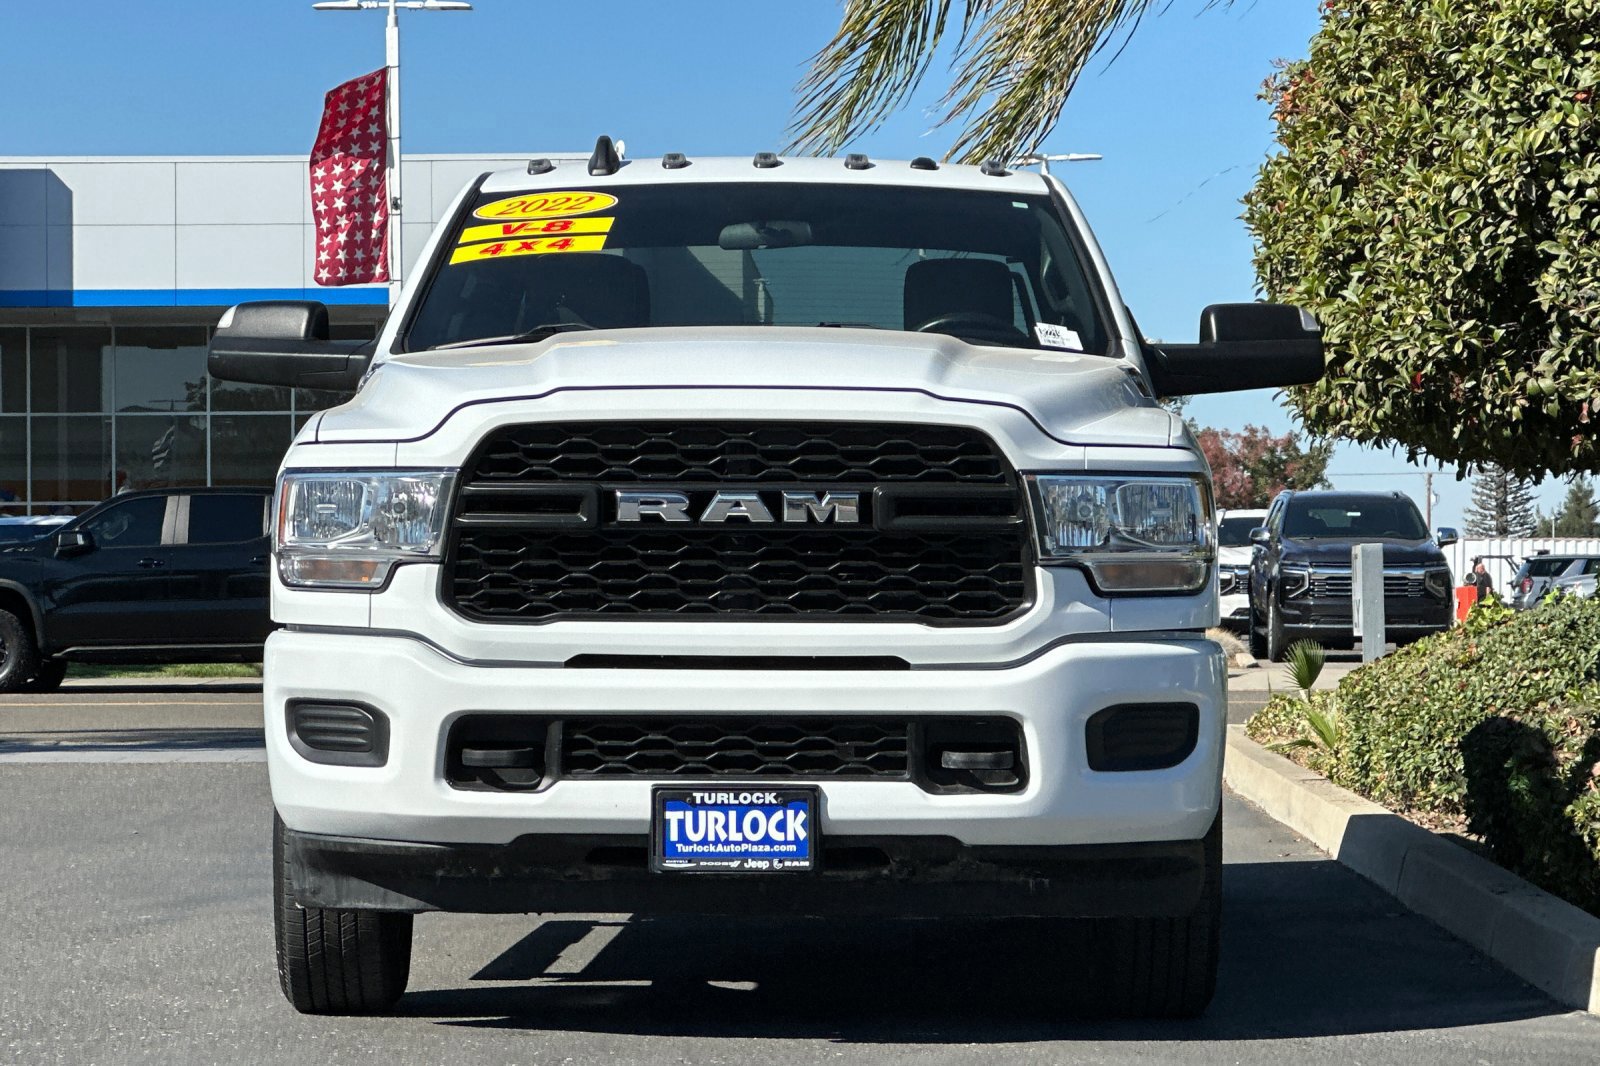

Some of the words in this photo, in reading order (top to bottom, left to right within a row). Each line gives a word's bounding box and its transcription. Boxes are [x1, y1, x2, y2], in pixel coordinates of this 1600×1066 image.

[495, 195, 595, 216] 2022
[502, 219, 576, 236] V-8
[616, 490, 860, 523] RAM
[692, 792, 777, 805] TURLOCK
[665, 809, 807, 842] TURLOCK
[675, 843, 797, 853] TurlockAutoPlaza.com
[743, 858, 770, 870] Jeep
